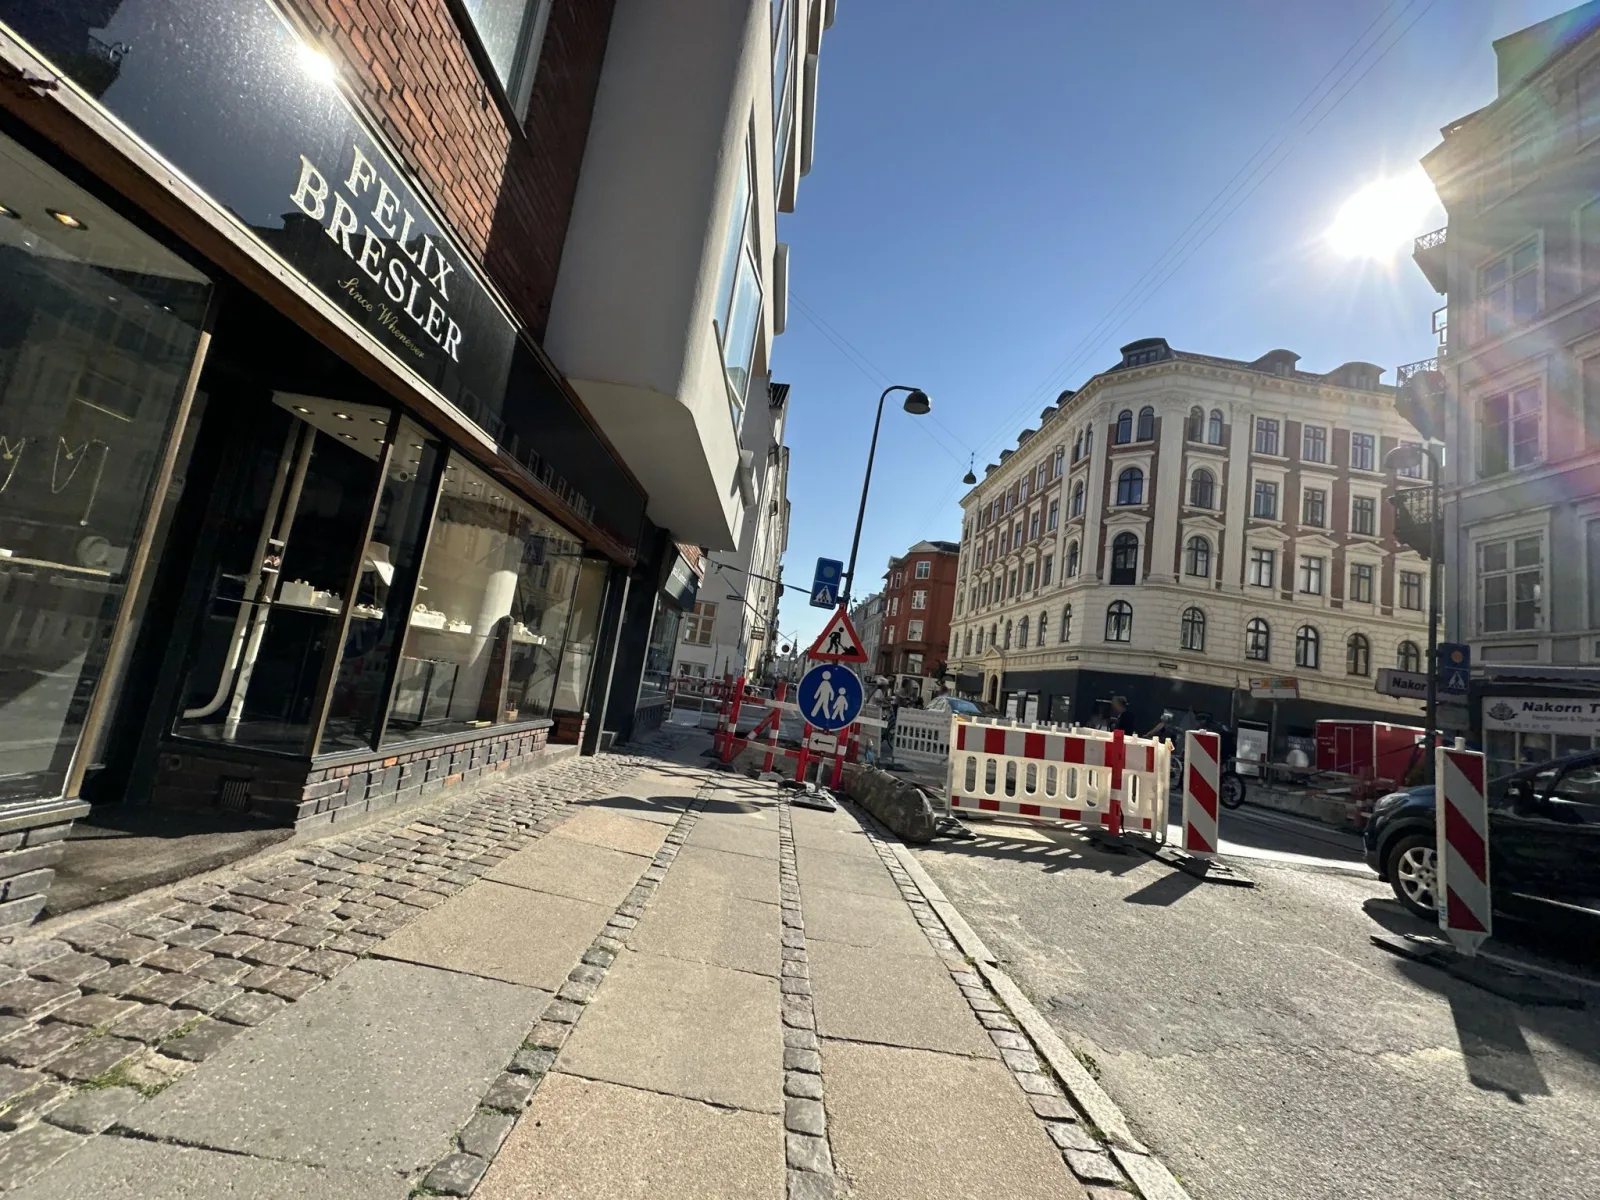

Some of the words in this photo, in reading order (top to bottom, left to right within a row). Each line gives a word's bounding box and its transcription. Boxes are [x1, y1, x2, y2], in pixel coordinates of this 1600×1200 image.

[289, 153, 462, 363] BRESLER
[343, 144, 454, 301] FELIX
[337, 277, 373, 312] Since
[377, 302, 425, 359] Whenever
[1392, 677, 1427, 691] Nakor
[1522, 701, 1582, 713] Nakorn
